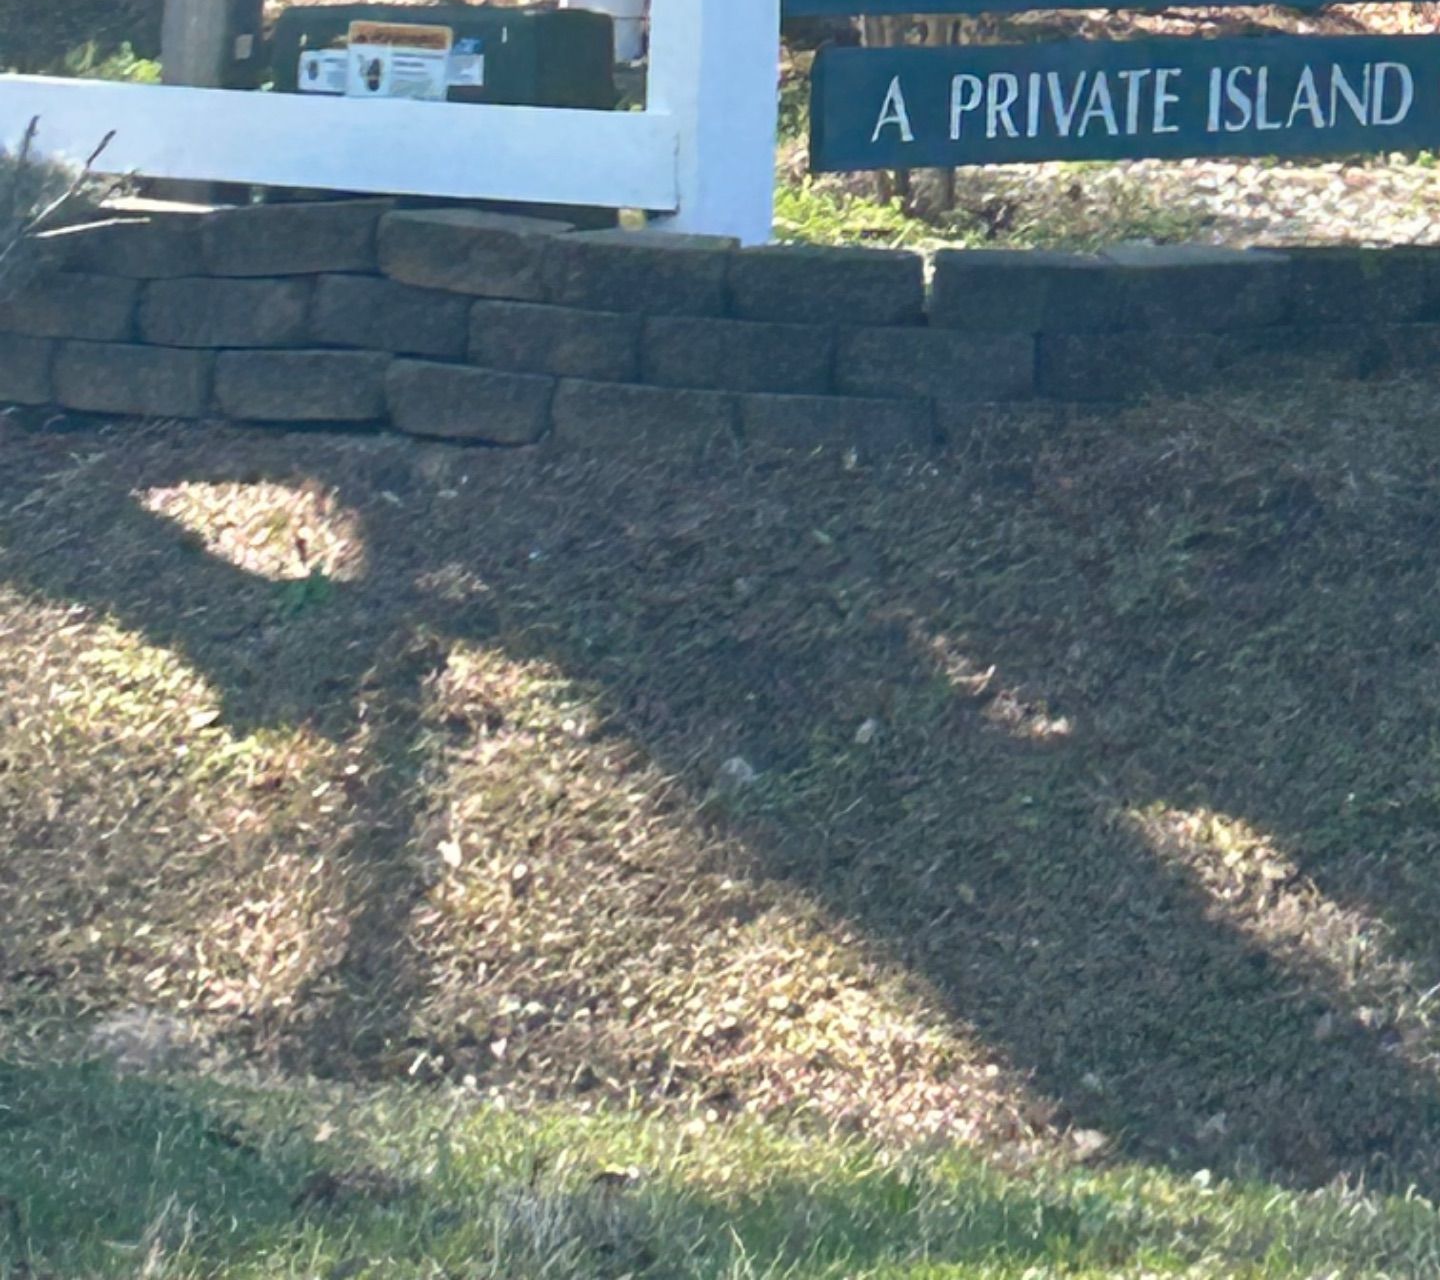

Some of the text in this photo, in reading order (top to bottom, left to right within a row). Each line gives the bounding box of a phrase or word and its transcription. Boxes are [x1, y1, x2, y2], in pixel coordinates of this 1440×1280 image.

[871, 76, 913, 143] A
[950, 66, 1181, 139] PRIVATE
[1206, 61, 1413, 132] ISLAND
